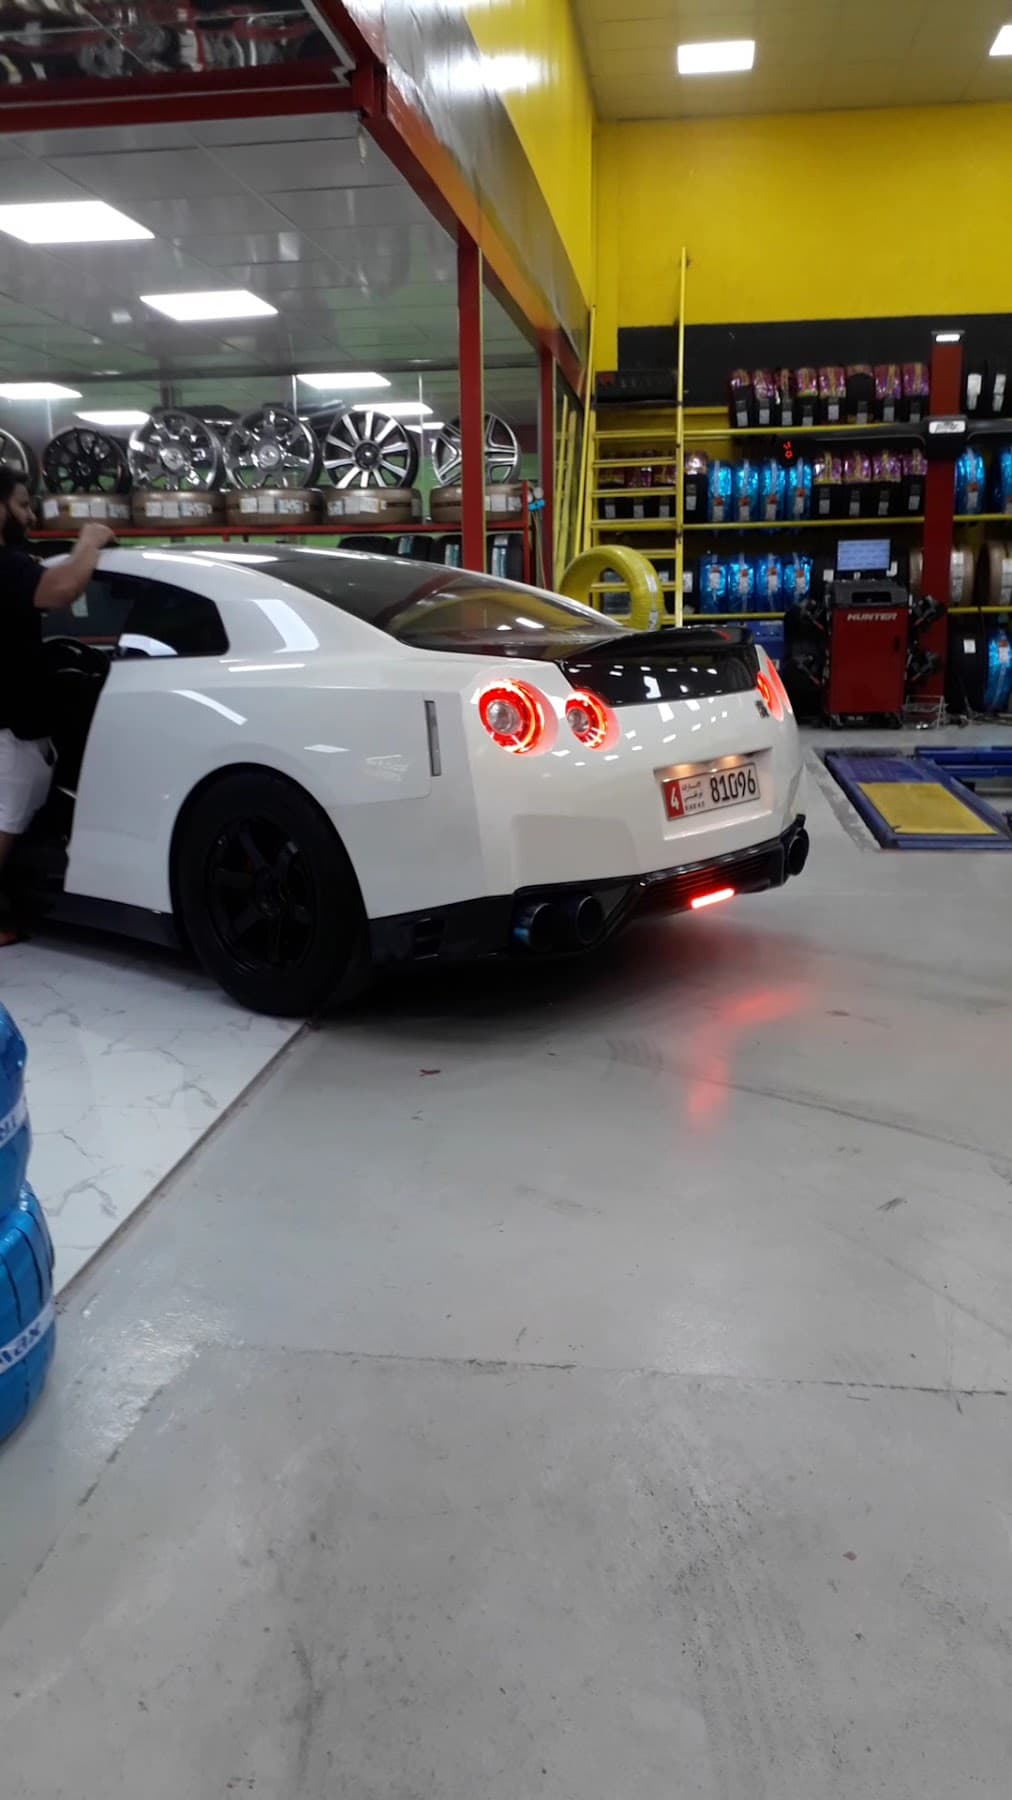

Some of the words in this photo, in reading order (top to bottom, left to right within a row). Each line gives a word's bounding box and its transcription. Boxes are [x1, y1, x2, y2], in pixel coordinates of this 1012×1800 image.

[847, 612, 898, 622] HUNTER
[670, 787, 680, 811] 4
[710, 769, 756, 803] 81096
